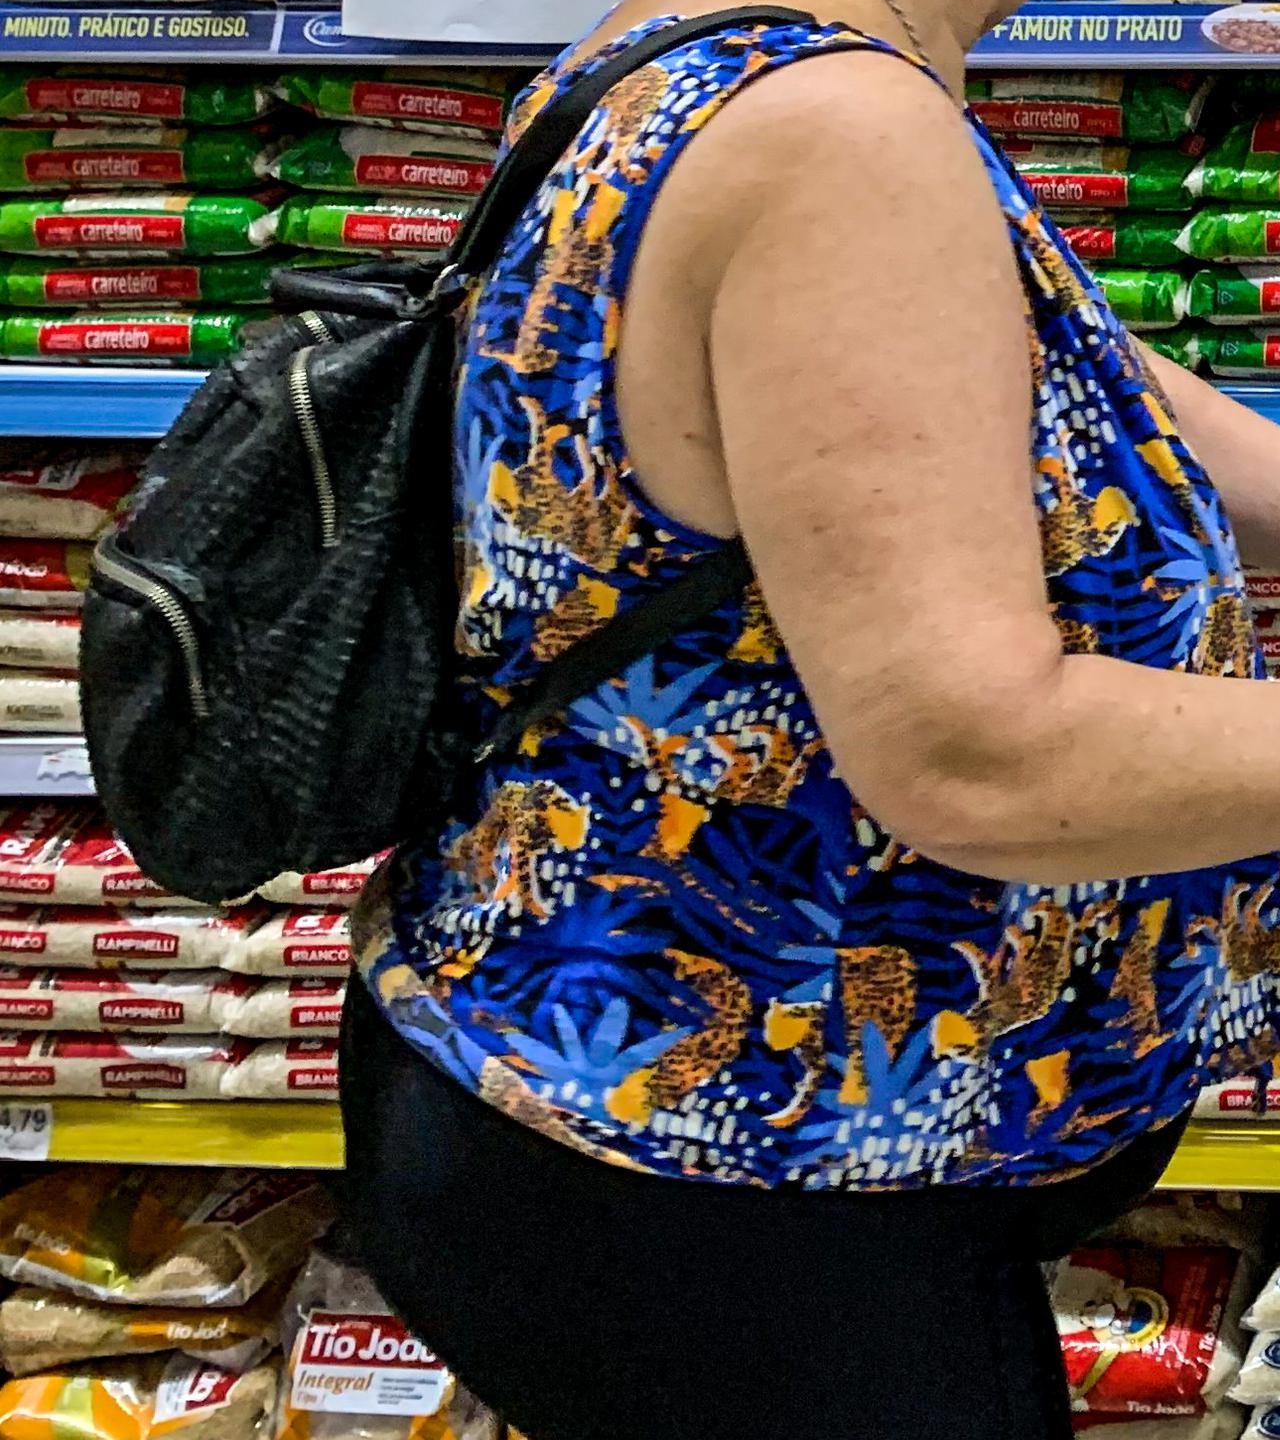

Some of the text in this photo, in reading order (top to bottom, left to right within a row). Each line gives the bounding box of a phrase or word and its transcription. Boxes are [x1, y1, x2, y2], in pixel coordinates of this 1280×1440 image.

[4, 13, 249, 38] MINUTO. PRÁTICO E GOSTOSO.
[1079, 15, 1109, 42] NO
[1115, 15, 1183, 41] PRATO
[73, 88, 141, 109] carreteiro
[398, 95, 462, 116] carreteiro
[80, 224, 144, 242] carreteiro
[84, 328, 150, 350] carreteiro
[97, 938, 348, 962] RAMPINELLI BRANCO
[103, 1005, 180, 1020] RAMPINELLI
[310, 1323, 356, 1359] Tio
[299, 1371, 375, 1395] Integral
